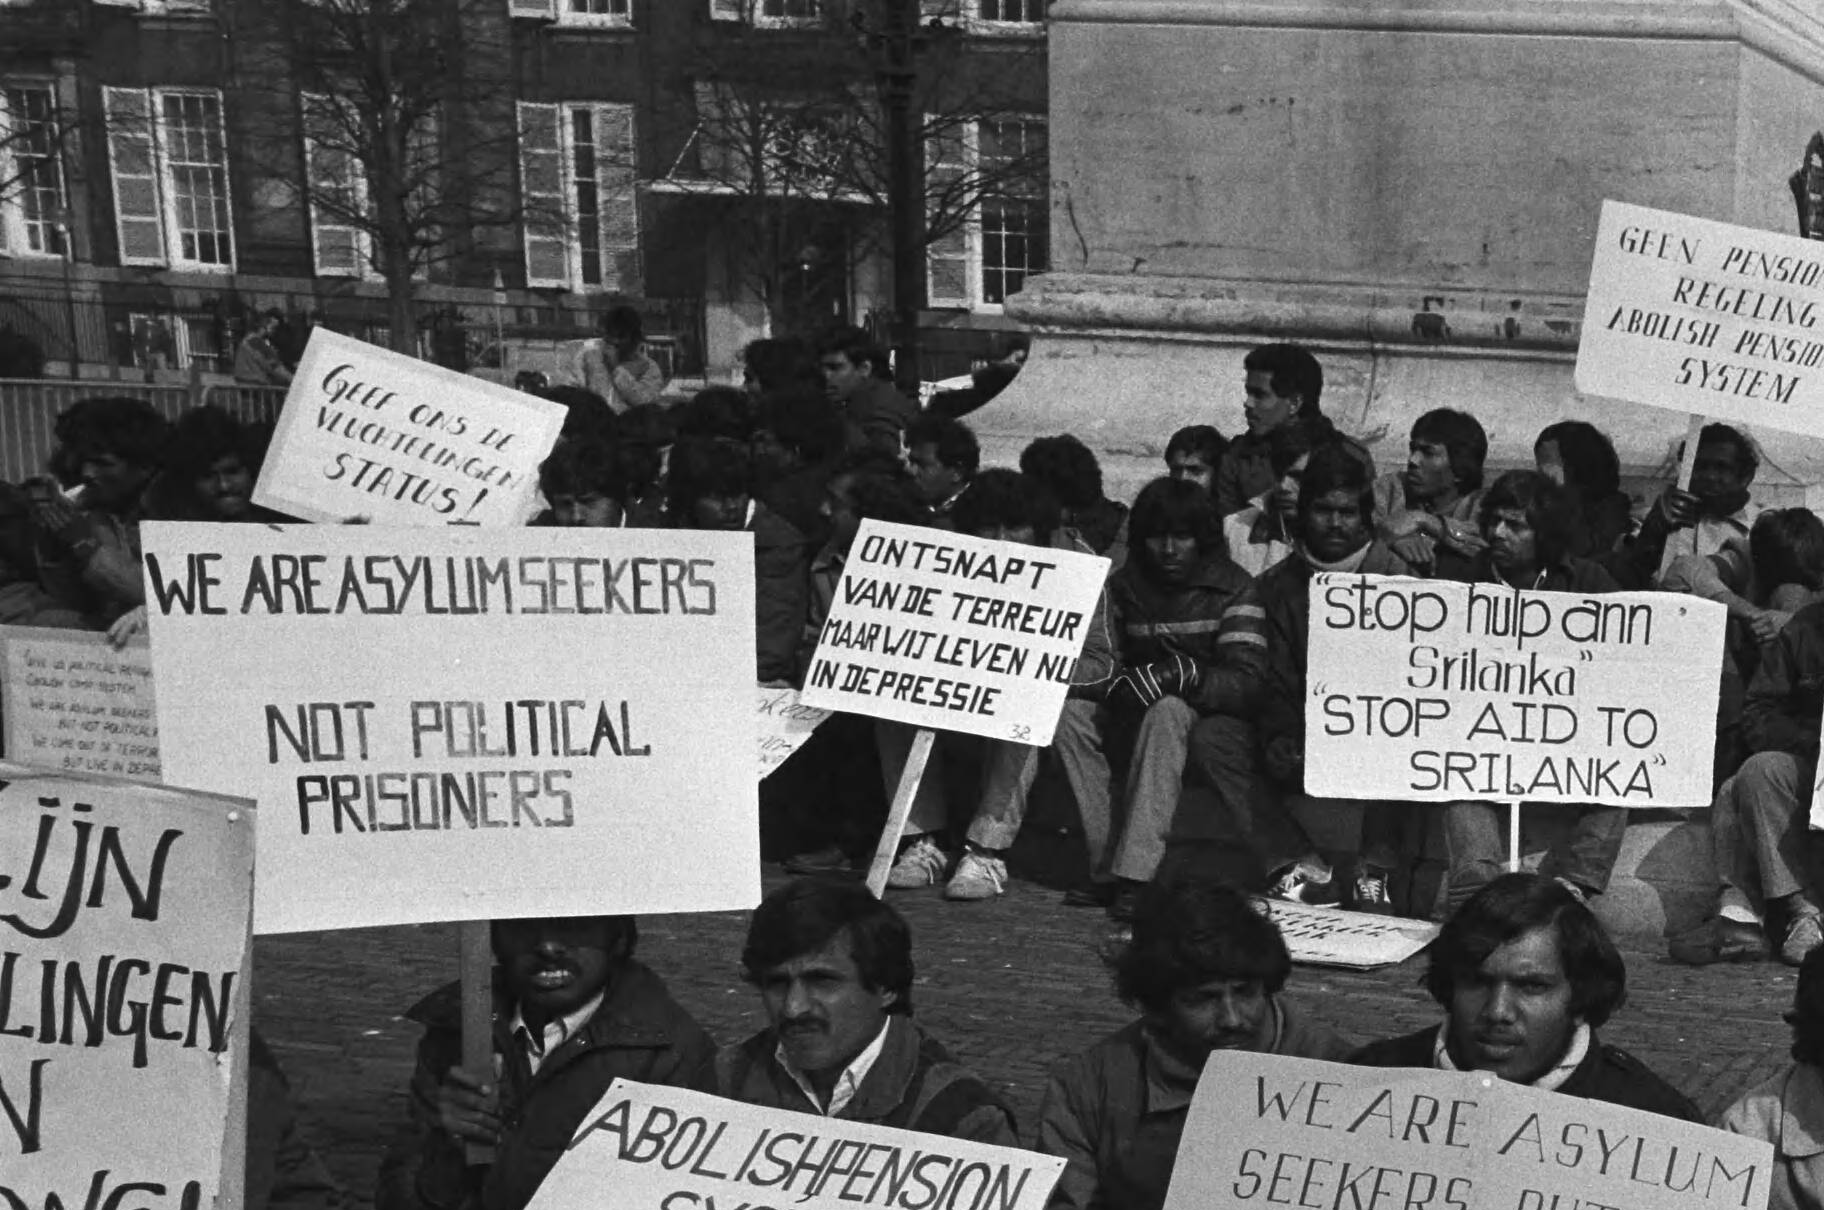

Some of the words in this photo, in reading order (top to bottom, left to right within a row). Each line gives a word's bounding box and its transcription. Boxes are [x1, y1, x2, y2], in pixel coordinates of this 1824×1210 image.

[1619, 226, 1702, 265] GEEN
[1607, 305, 1721, 349] ABOLISH
[1675, 356, 1803, 405] SYSTEM
[316, 405, 524, 492] VLUCHTELINGEN
[409, 404, 469, 436] ONS
[479, 428, 516, 452] DE
[145, 552, 229, 616] WE
[860, 535, 1058, 590] ONTSNAPT
[845, 575, 902, 611] VAN
[951, 591, 1083, 642] TERREUR
[1467, 582, 1551, 650] hulp
[820, 618, 882, 653] MAAR
[933, 633, 1030, 676] LEVEN
[1034, 652, 1080, 684] NU
[810, 658, 841, 690] IN
[839, 663, 1003, 717] DEPRESSIE
[265, 702, 377, 765] NOT
[411, 700, 651, 759] POLITICAL
[1466, 700, 1579, 745] AID
[1597, 705, 1659, 749] TO
[298, 770, 576, 836] PRISONERS
[1256, 1074, 1344, 1131] WE
[1346, 1088, 1479, 1149] ARE
[1497, 1112, 1758, 1209] ASYLUM
